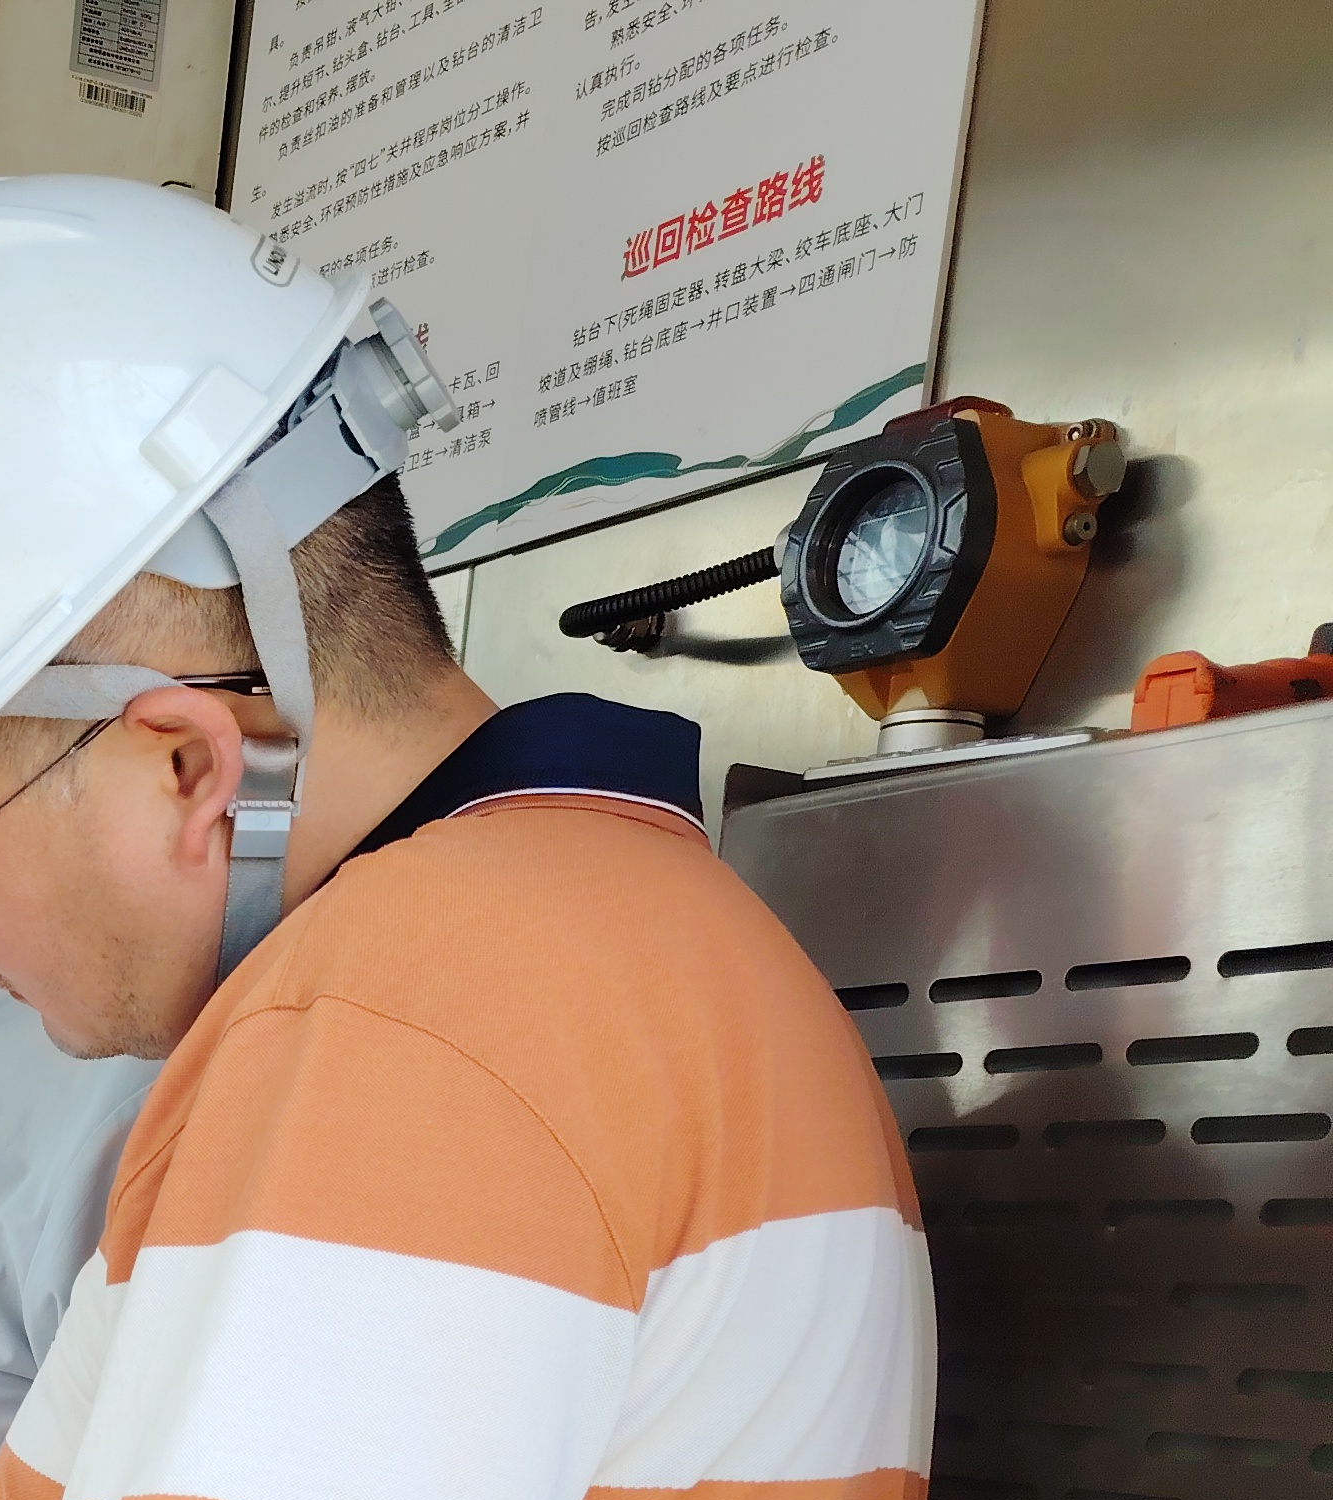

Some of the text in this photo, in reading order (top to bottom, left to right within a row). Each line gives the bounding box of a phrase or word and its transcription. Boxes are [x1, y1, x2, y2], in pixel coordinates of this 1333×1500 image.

[621, 154, 826, 281] 巡回检查路线
